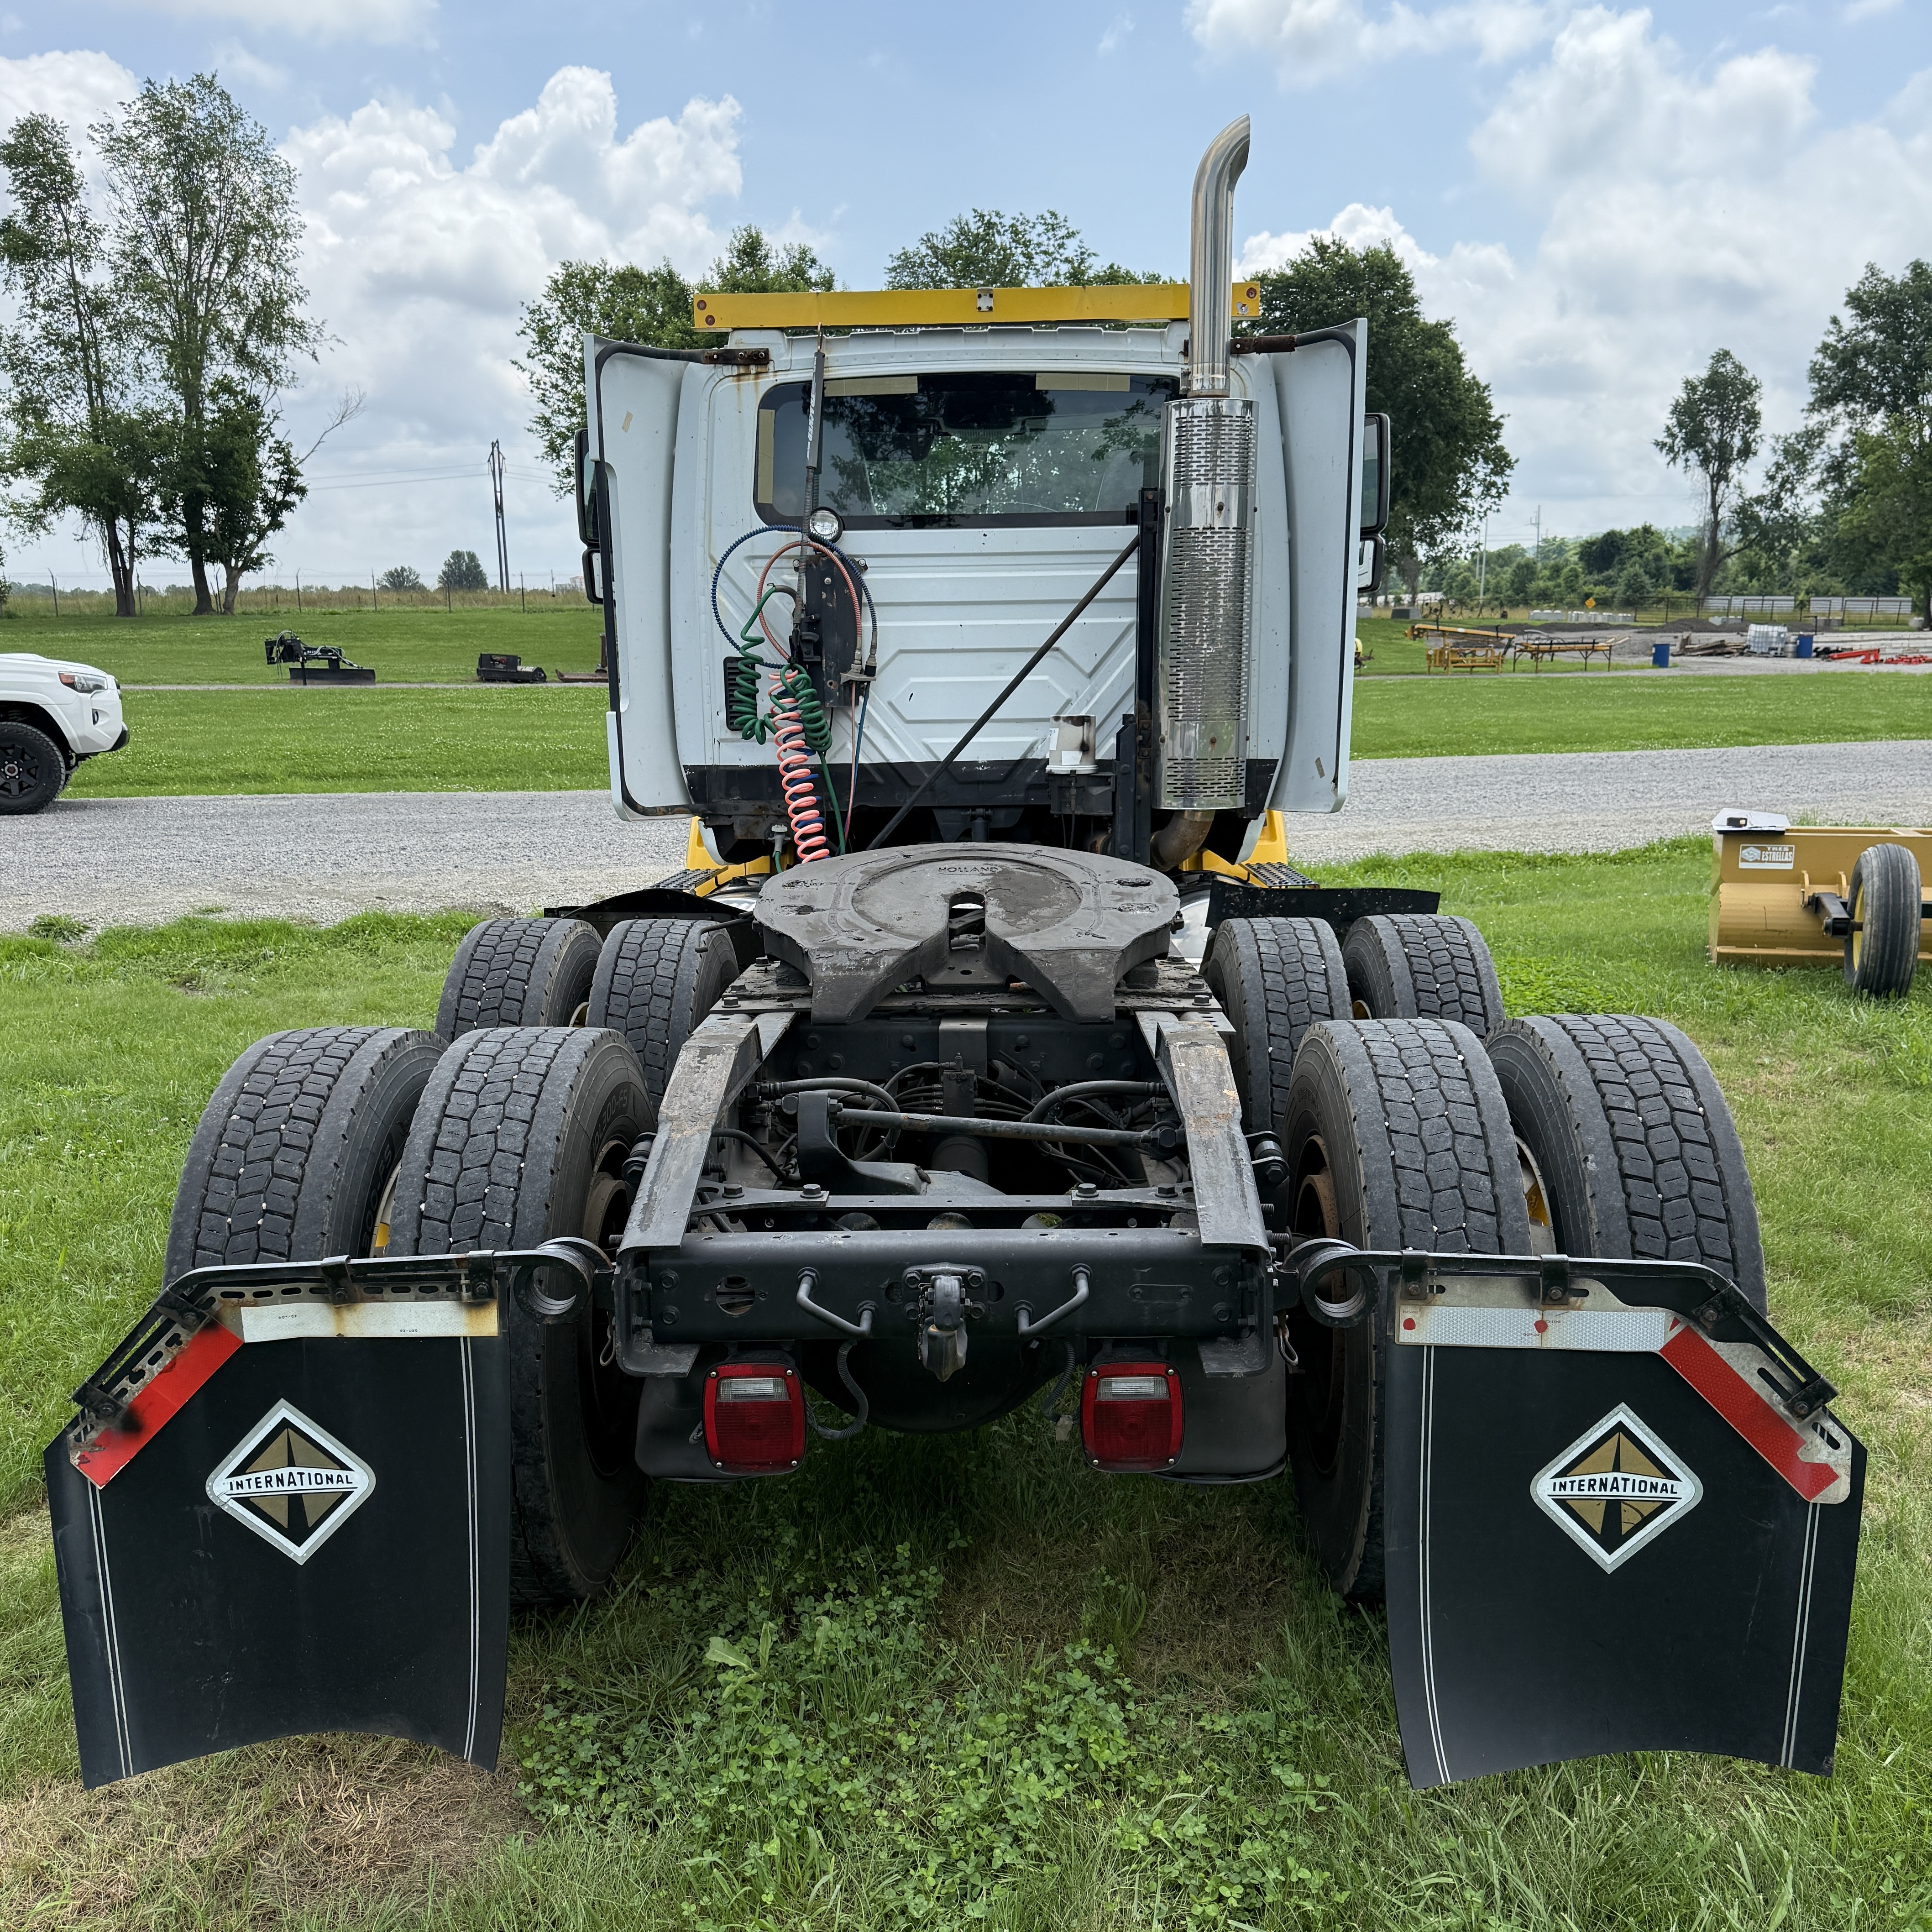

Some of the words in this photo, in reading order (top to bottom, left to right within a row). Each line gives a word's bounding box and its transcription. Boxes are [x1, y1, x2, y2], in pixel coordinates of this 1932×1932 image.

[1762, 851, 1792, 862] ESTRELLAS
[230, 1471, 353, 1491] INTERNATIONAL
[1553, 1476, 1678, 1494] INTERNATIONAL
